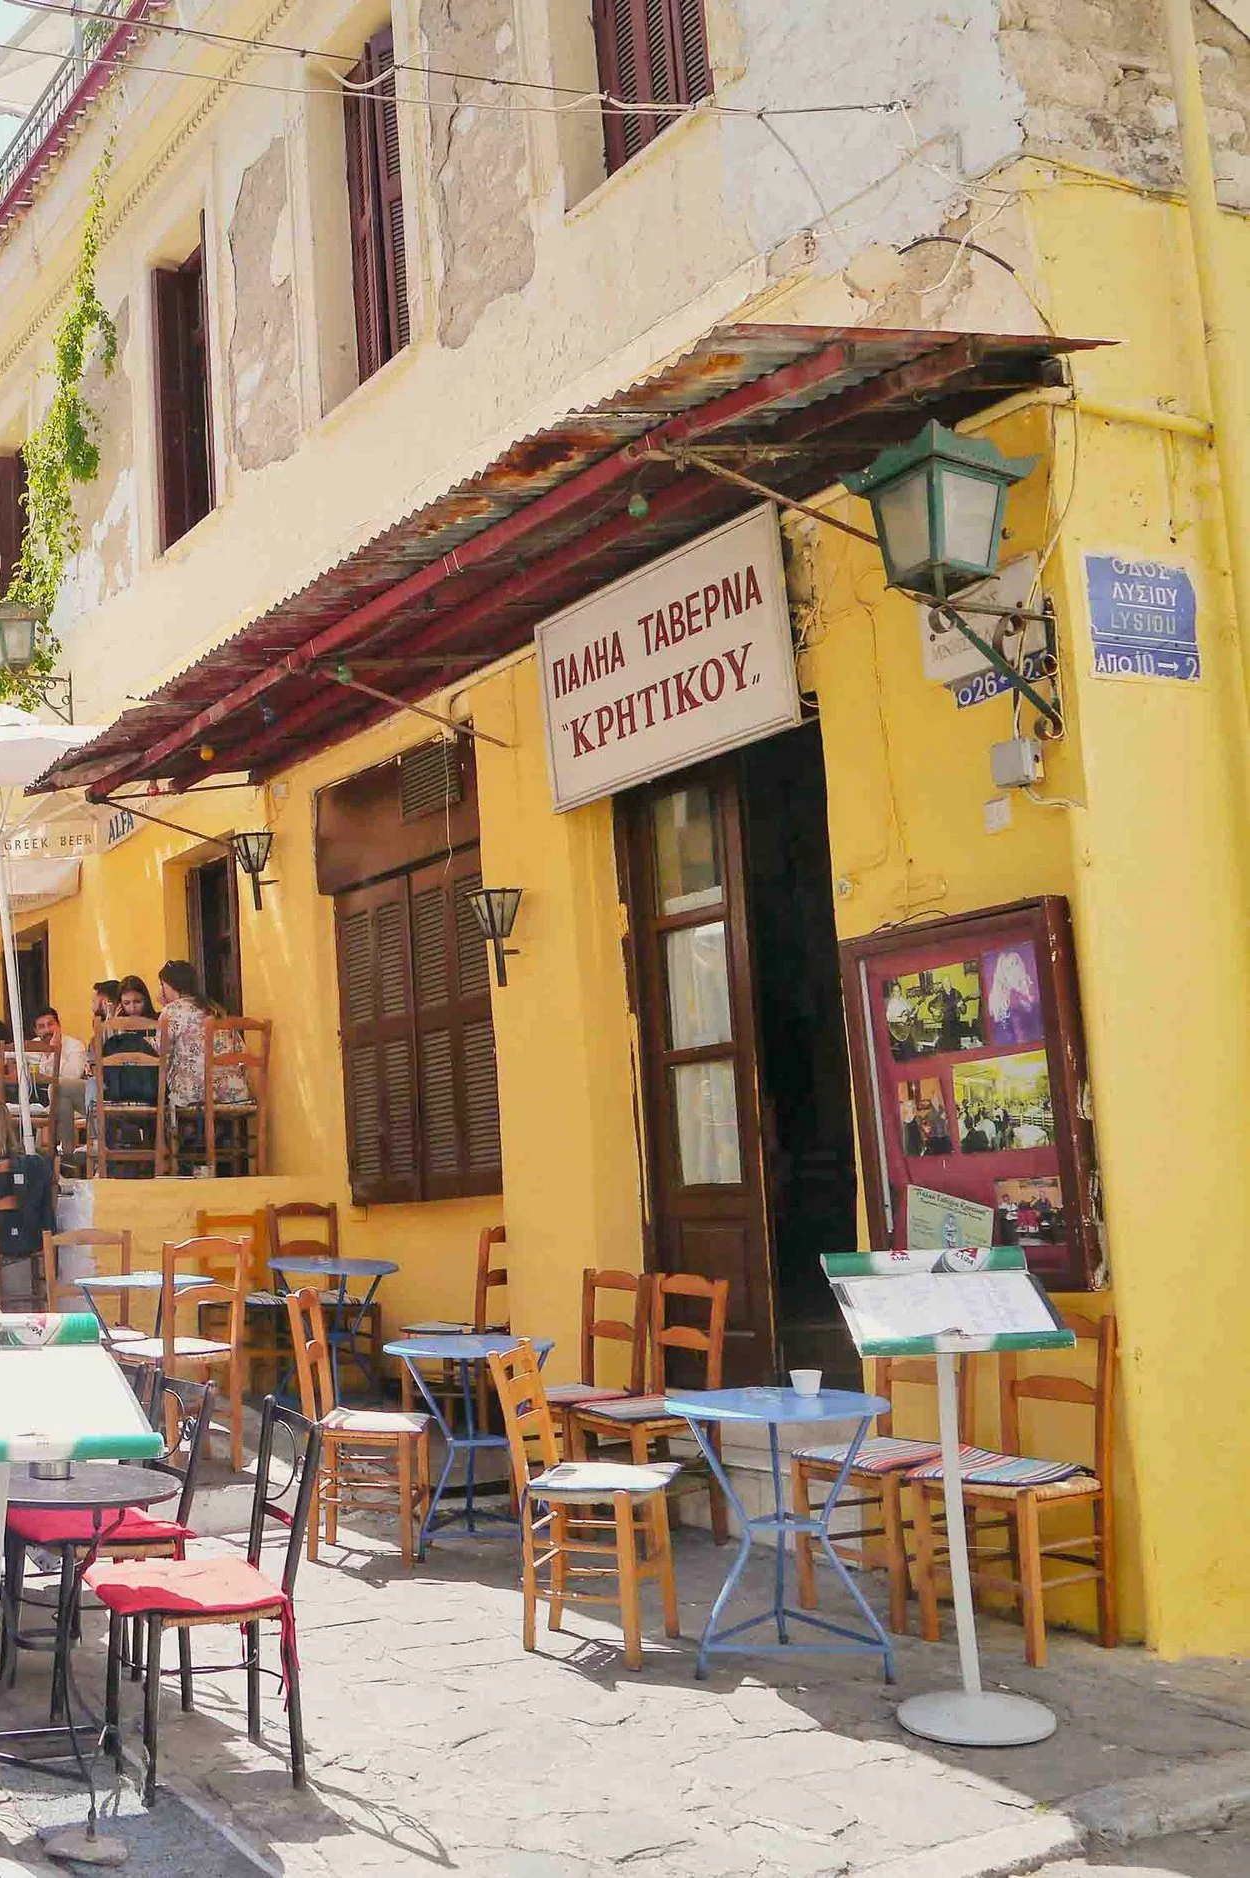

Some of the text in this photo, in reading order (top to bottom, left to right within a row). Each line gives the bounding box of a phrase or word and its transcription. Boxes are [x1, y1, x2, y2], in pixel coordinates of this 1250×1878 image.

[1112, 581, 1178, 607] ΛΥΣΙΟΥ
[552, 564, 763, 700] ΠΑΛΗΑ ΤΑΒΕΡΝΑ
[1110, 610, 1177, 635] LYSIOU
[108, 810, 134, 845] ALFA
[4, 833, 92, 851] GREEK BEER
